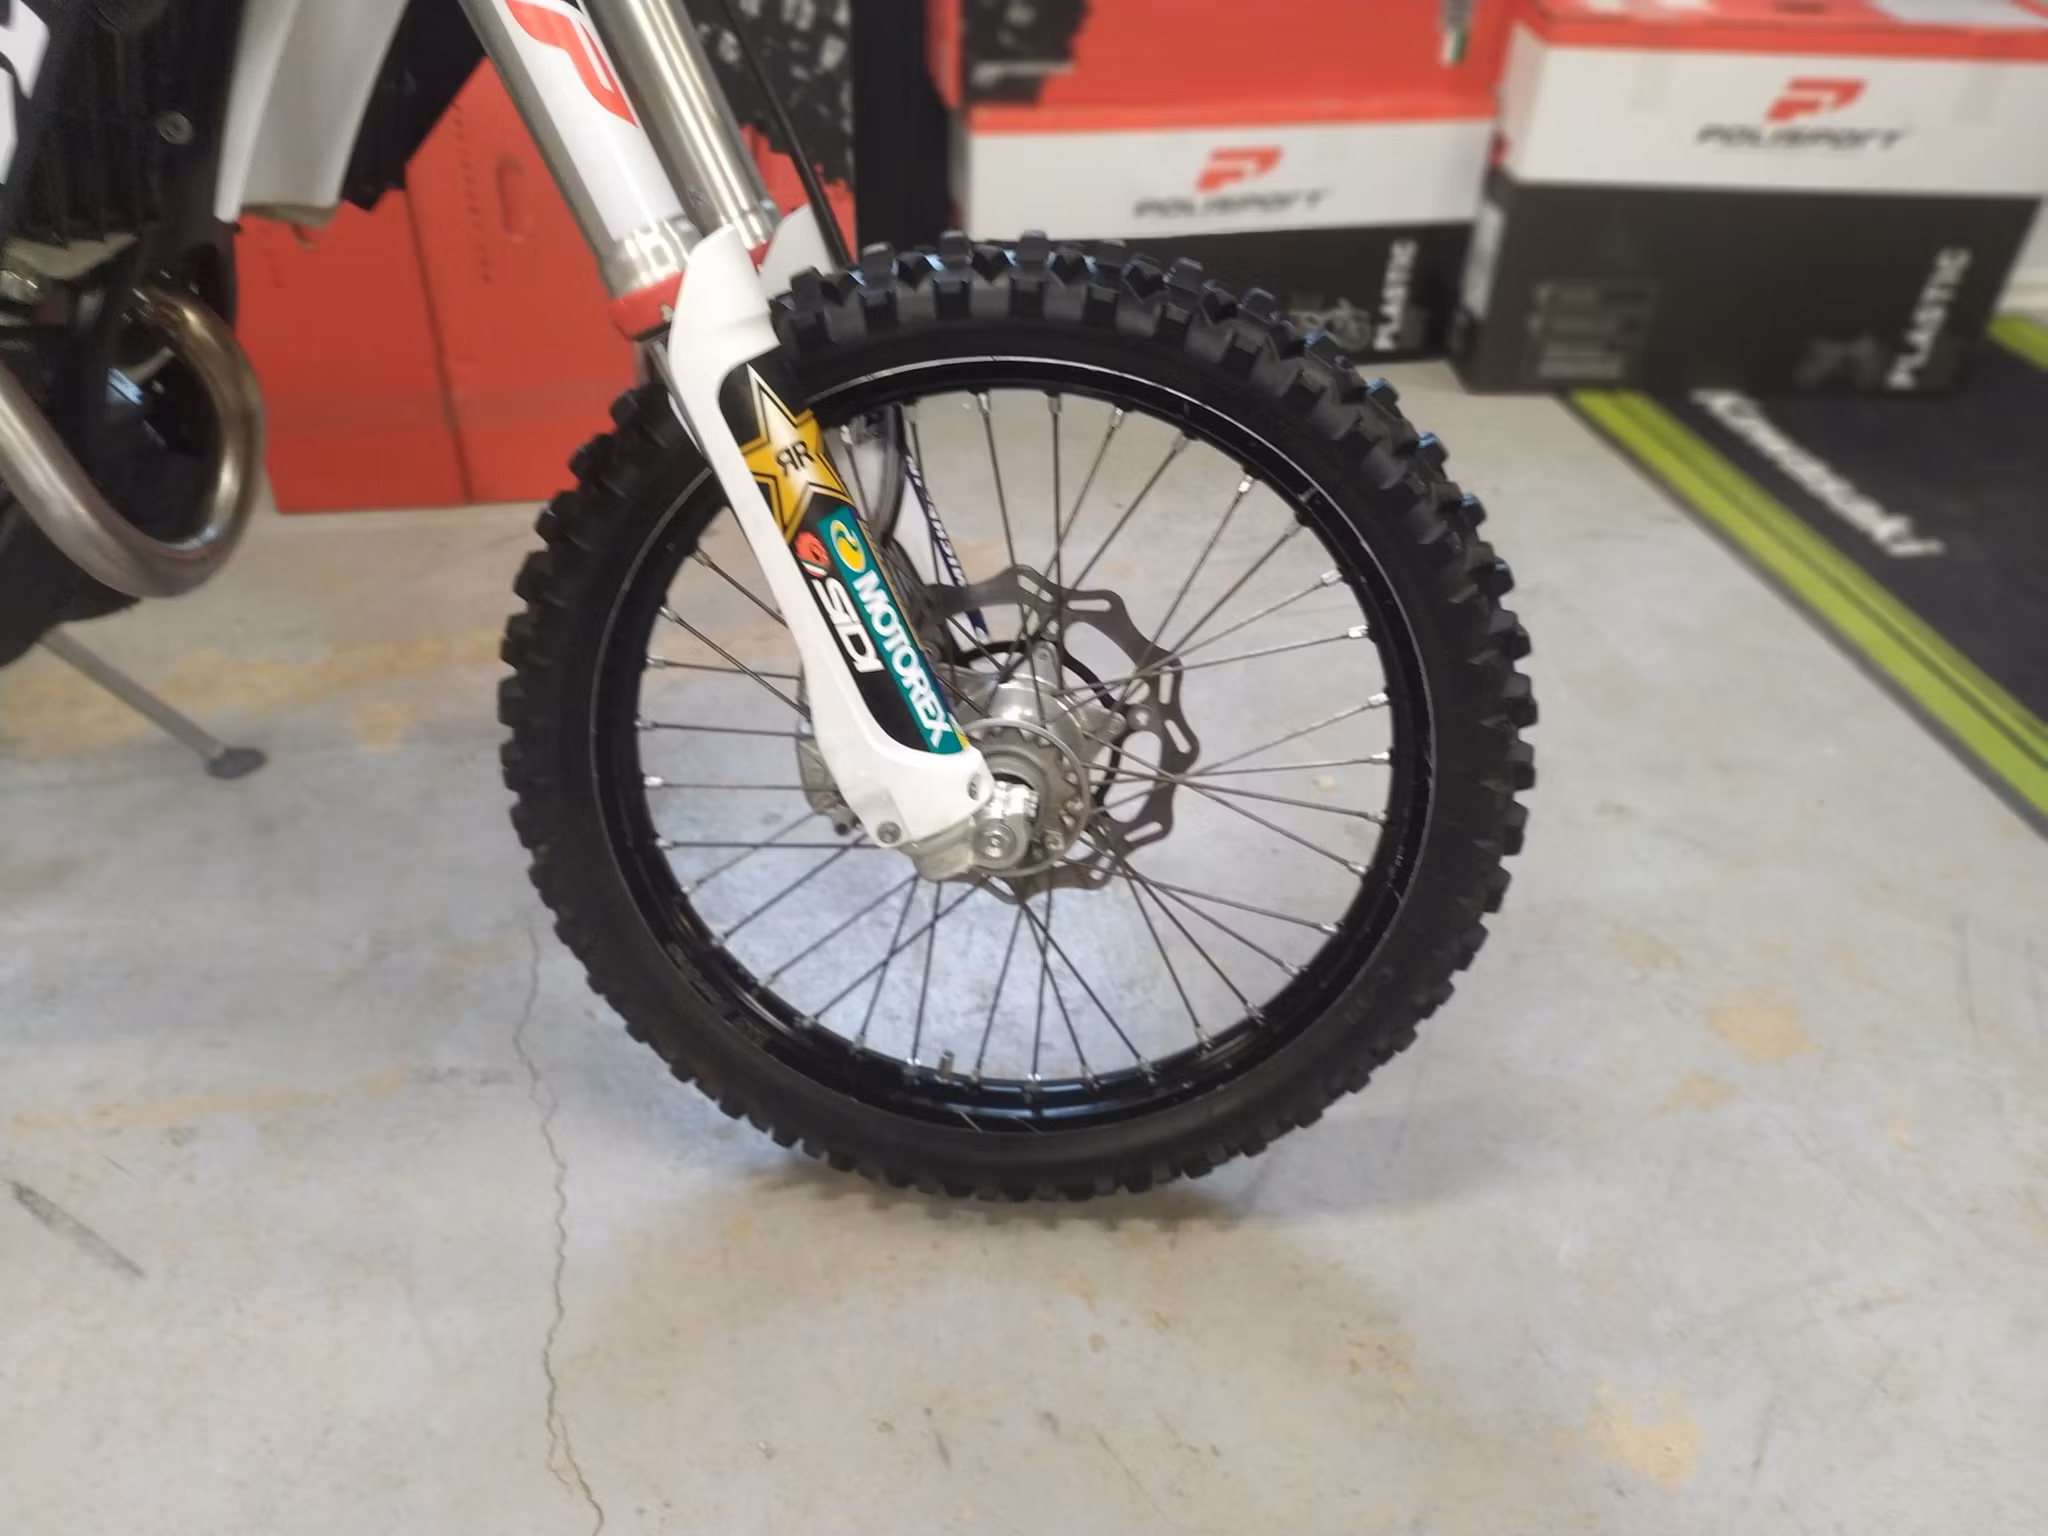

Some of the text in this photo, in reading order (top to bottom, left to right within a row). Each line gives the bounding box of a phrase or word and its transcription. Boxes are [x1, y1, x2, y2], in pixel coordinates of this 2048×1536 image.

[1696, 123, 1914, 151] POLISPORT
[1132, 185, 1333, 219] POLISPORT
[812, 577, 885, 673] SIDI
[853, 569, 954, 748] MOTOREX
